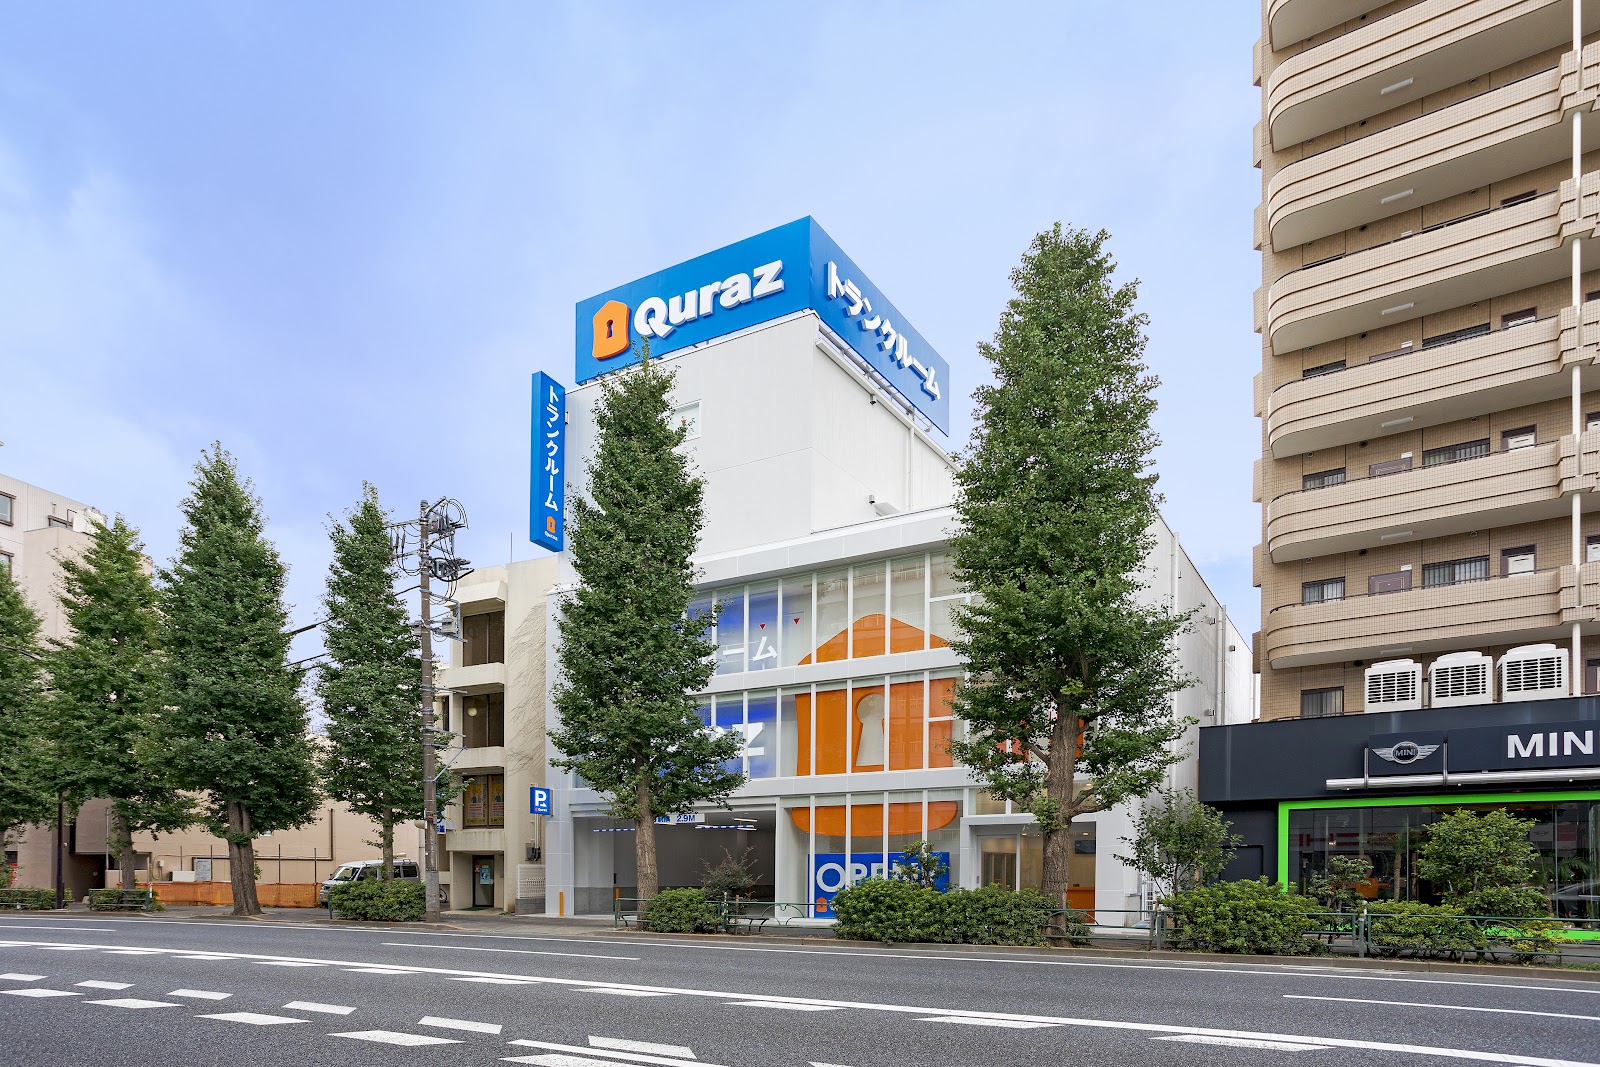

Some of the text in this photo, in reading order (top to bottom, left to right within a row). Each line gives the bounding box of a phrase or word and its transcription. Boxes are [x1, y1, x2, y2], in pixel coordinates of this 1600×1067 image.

[633, 260, 784, 338] Quraz
[827, 261, 941, 400] トランクルーム
[545, 385, 560, 512] トランクルーム
[1395, 749, 1416, 758] MINI
[1507, 729, 1600, 759] MIN
[534, 789, 547, 806] P
[676, 814, 696, 823] 2.9M
